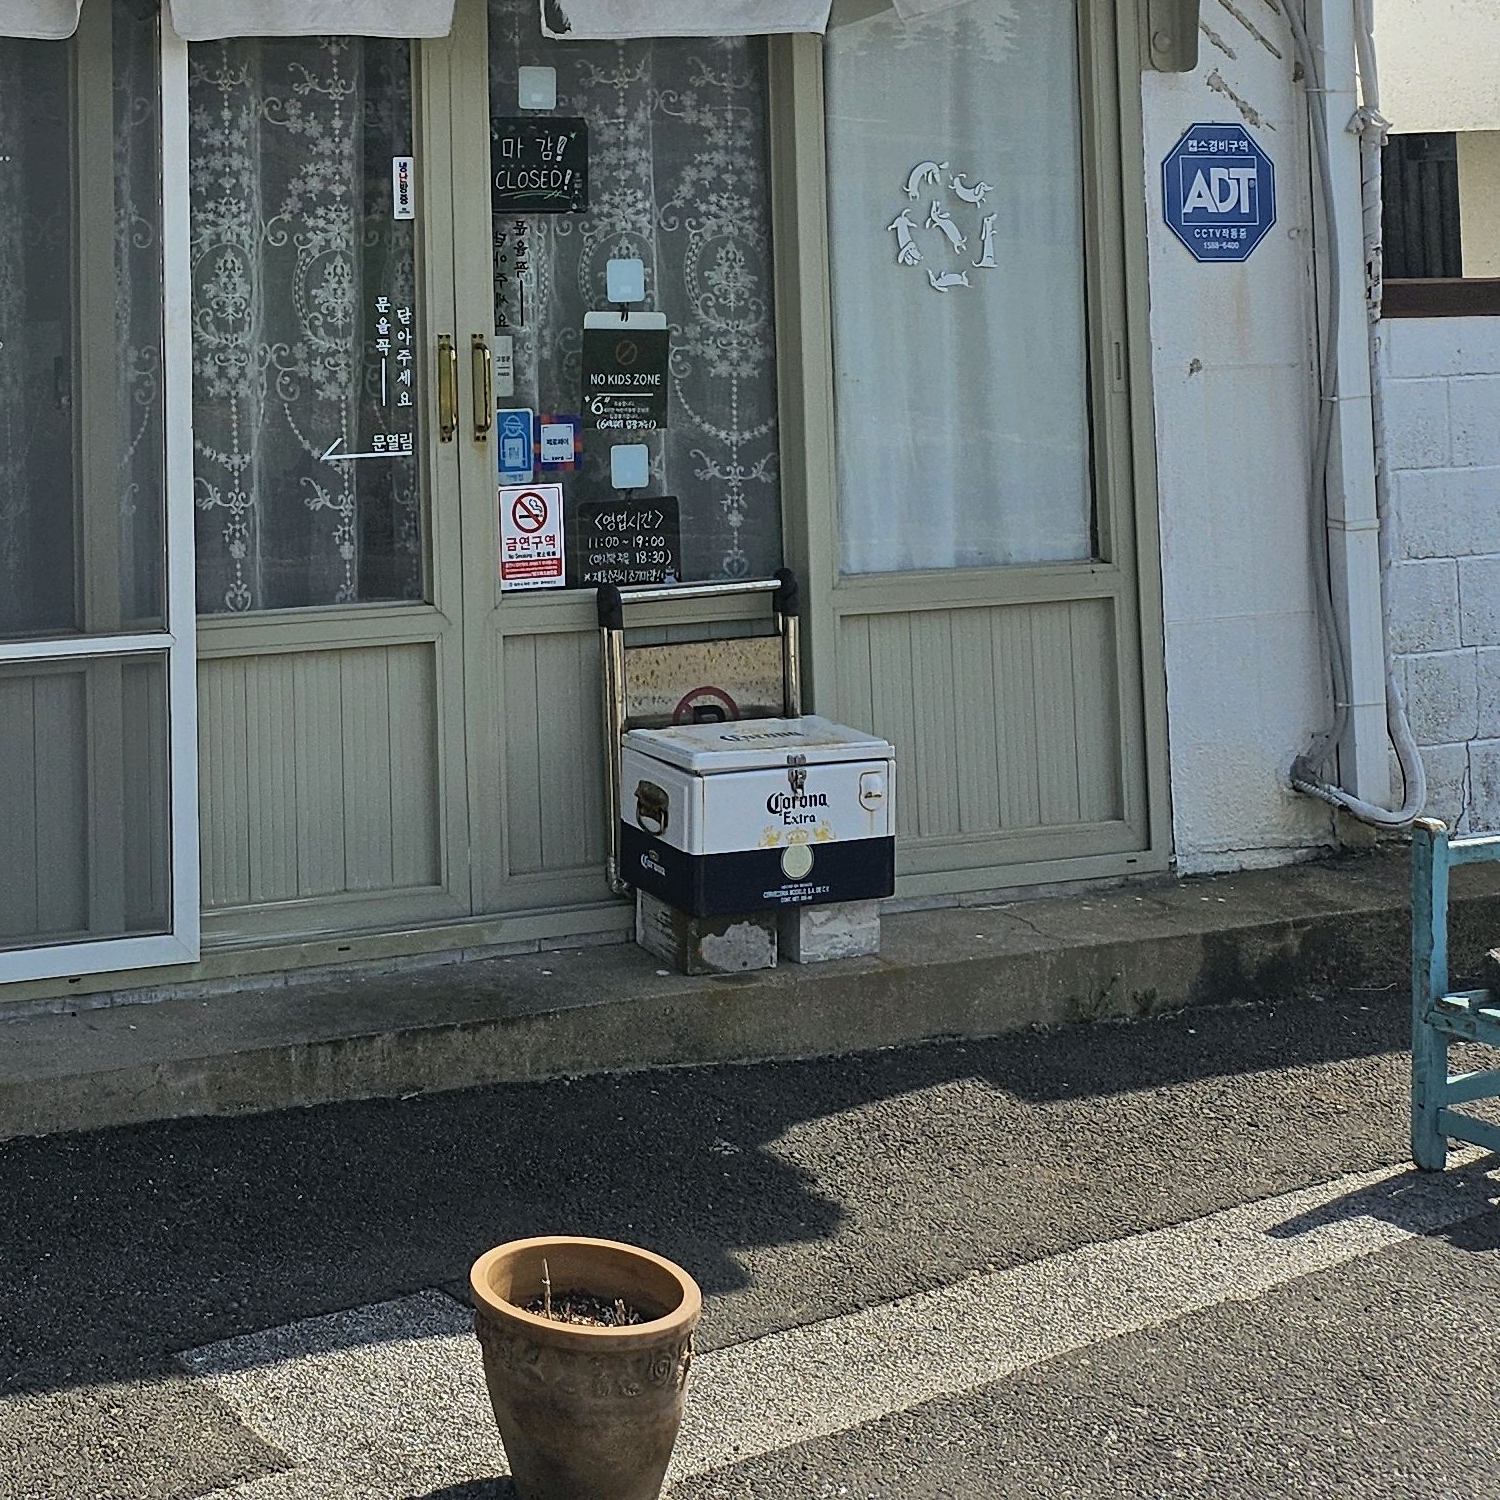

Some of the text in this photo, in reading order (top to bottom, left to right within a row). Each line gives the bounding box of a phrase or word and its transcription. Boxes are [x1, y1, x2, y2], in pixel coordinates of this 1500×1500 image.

[1188, 140, 1249, 152] 캡스경비구역
[495, 169, 572, 191] CLOSED!
[1182, 167, 1257, 213] ADT
[396, 306, 412, 407] 닫아주세요
[590, 373, 661, 385] NO KIDS ZONE
[372, 432, 413, 451] 문열림
[505, 534, 556, 551] 금연구역
[767, 792, 828, 816] Corona
[783, 811, 816, 825] Extra
